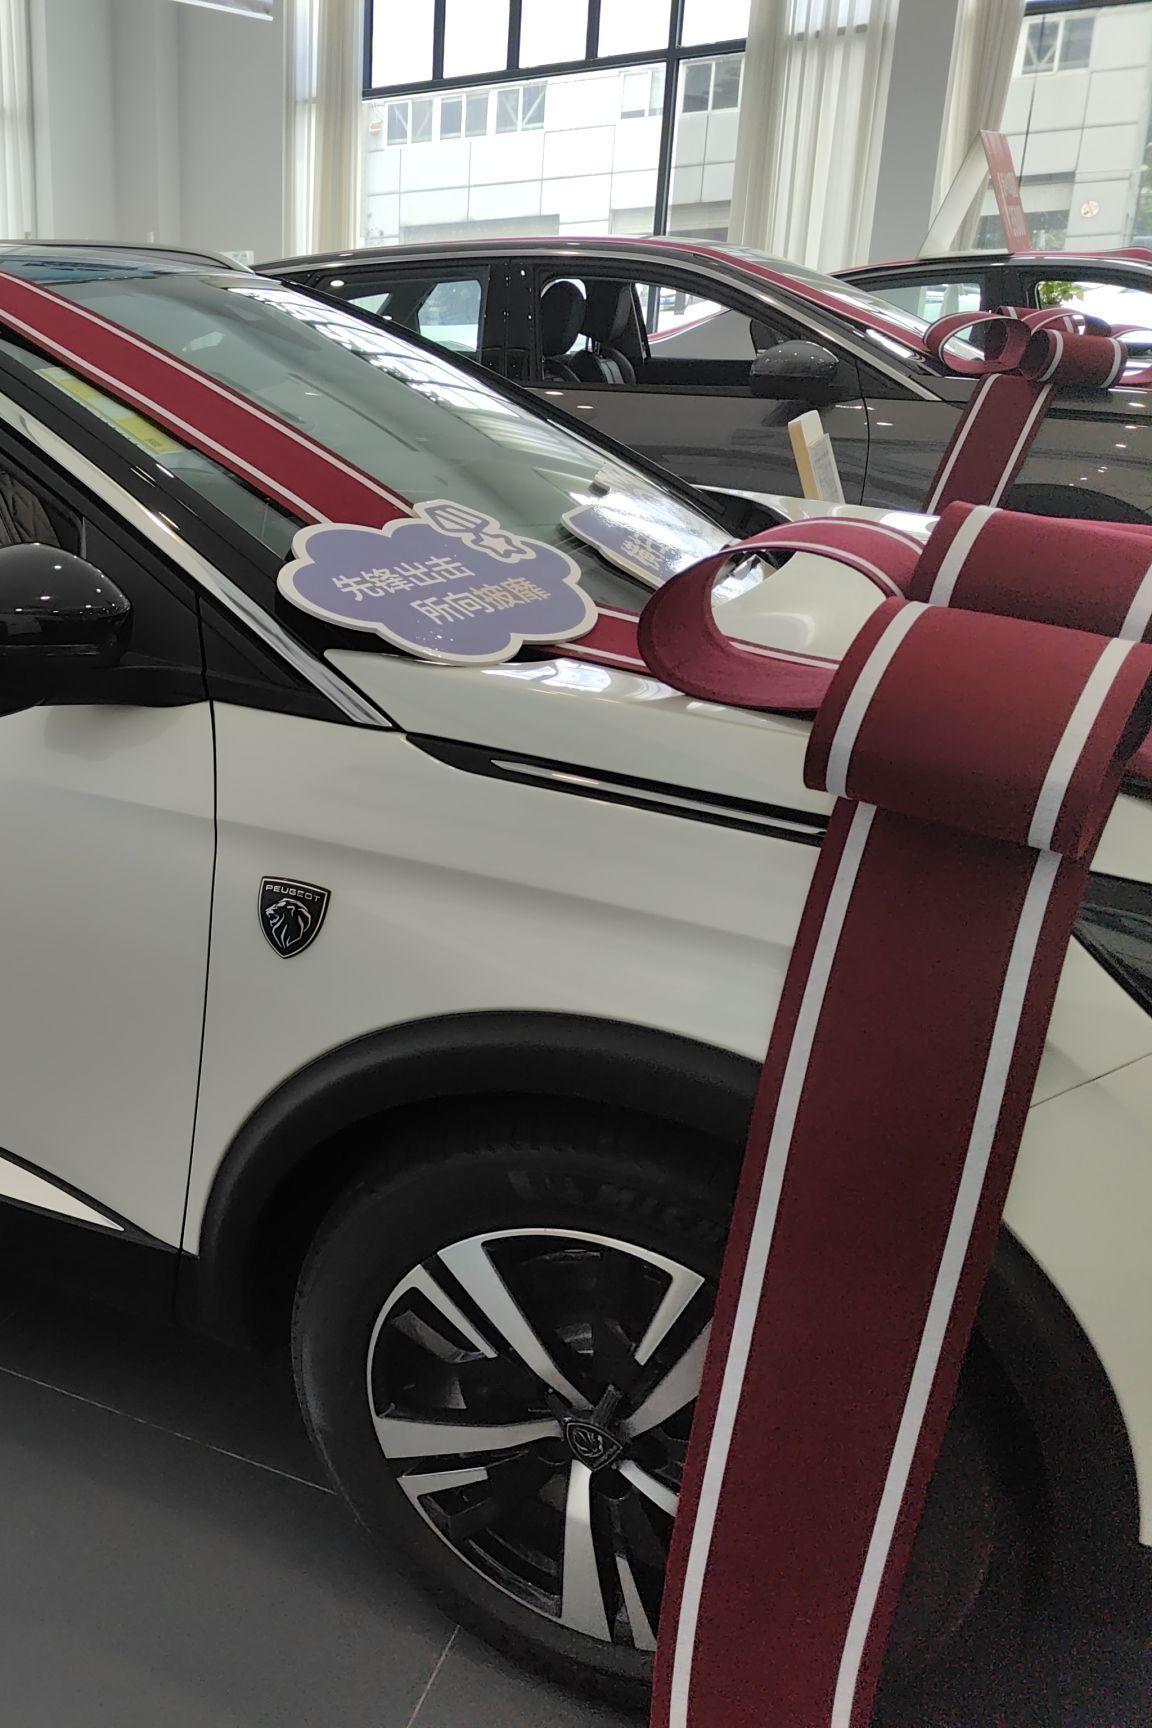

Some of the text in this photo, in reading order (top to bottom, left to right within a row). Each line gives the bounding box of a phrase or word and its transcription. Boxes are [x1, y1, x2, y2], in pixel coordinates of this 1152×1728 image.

[332, 555, 476, 602] 先锋出击
[410, 577, 552, 625] 所向披靡
[265, 884, 321, 902] PEUGEOT
